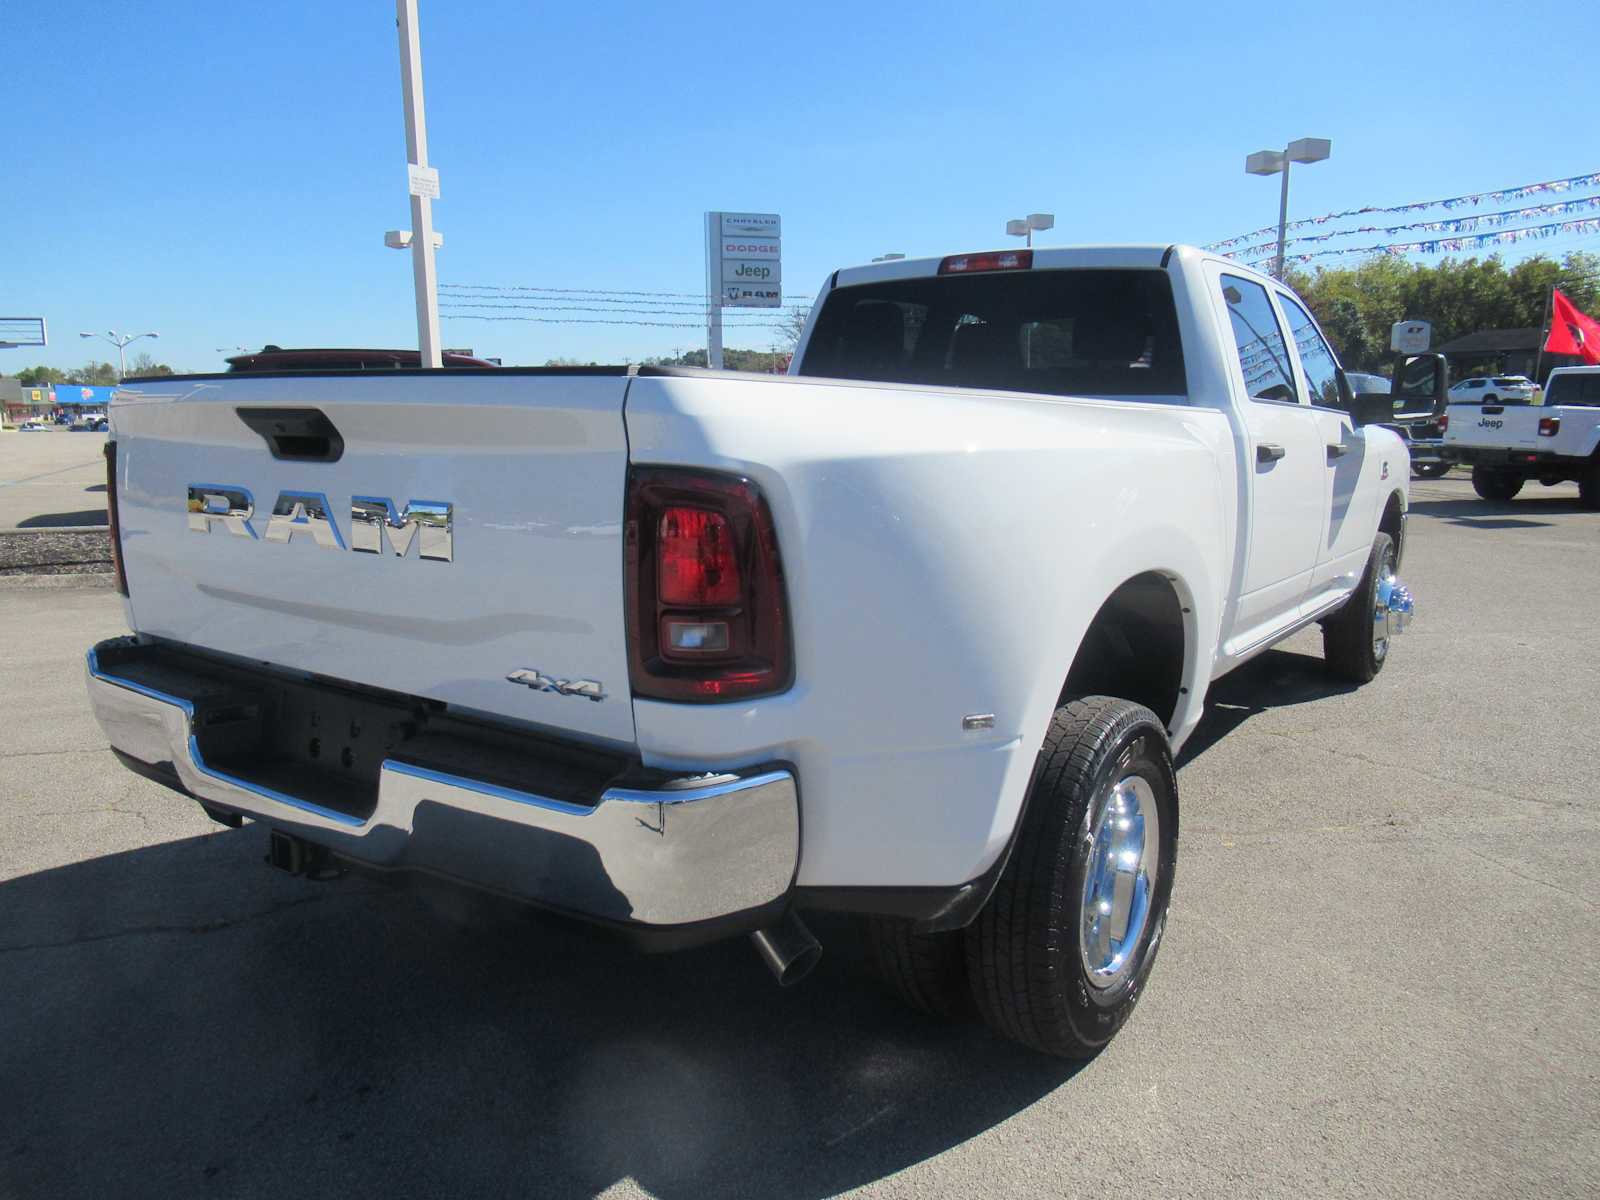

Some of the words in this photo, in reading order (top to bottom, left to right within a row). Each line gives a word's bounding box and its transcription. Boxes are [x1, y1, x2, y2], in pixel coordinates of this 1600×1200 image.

[725, 244, 779, 253] DODGE
[735, 263, 771, 280] Jeep
[742, 290, 779, 299] RAM
[1477, 417, 1504, 430] Jeep
[187, 483, 454, 563] RAM
